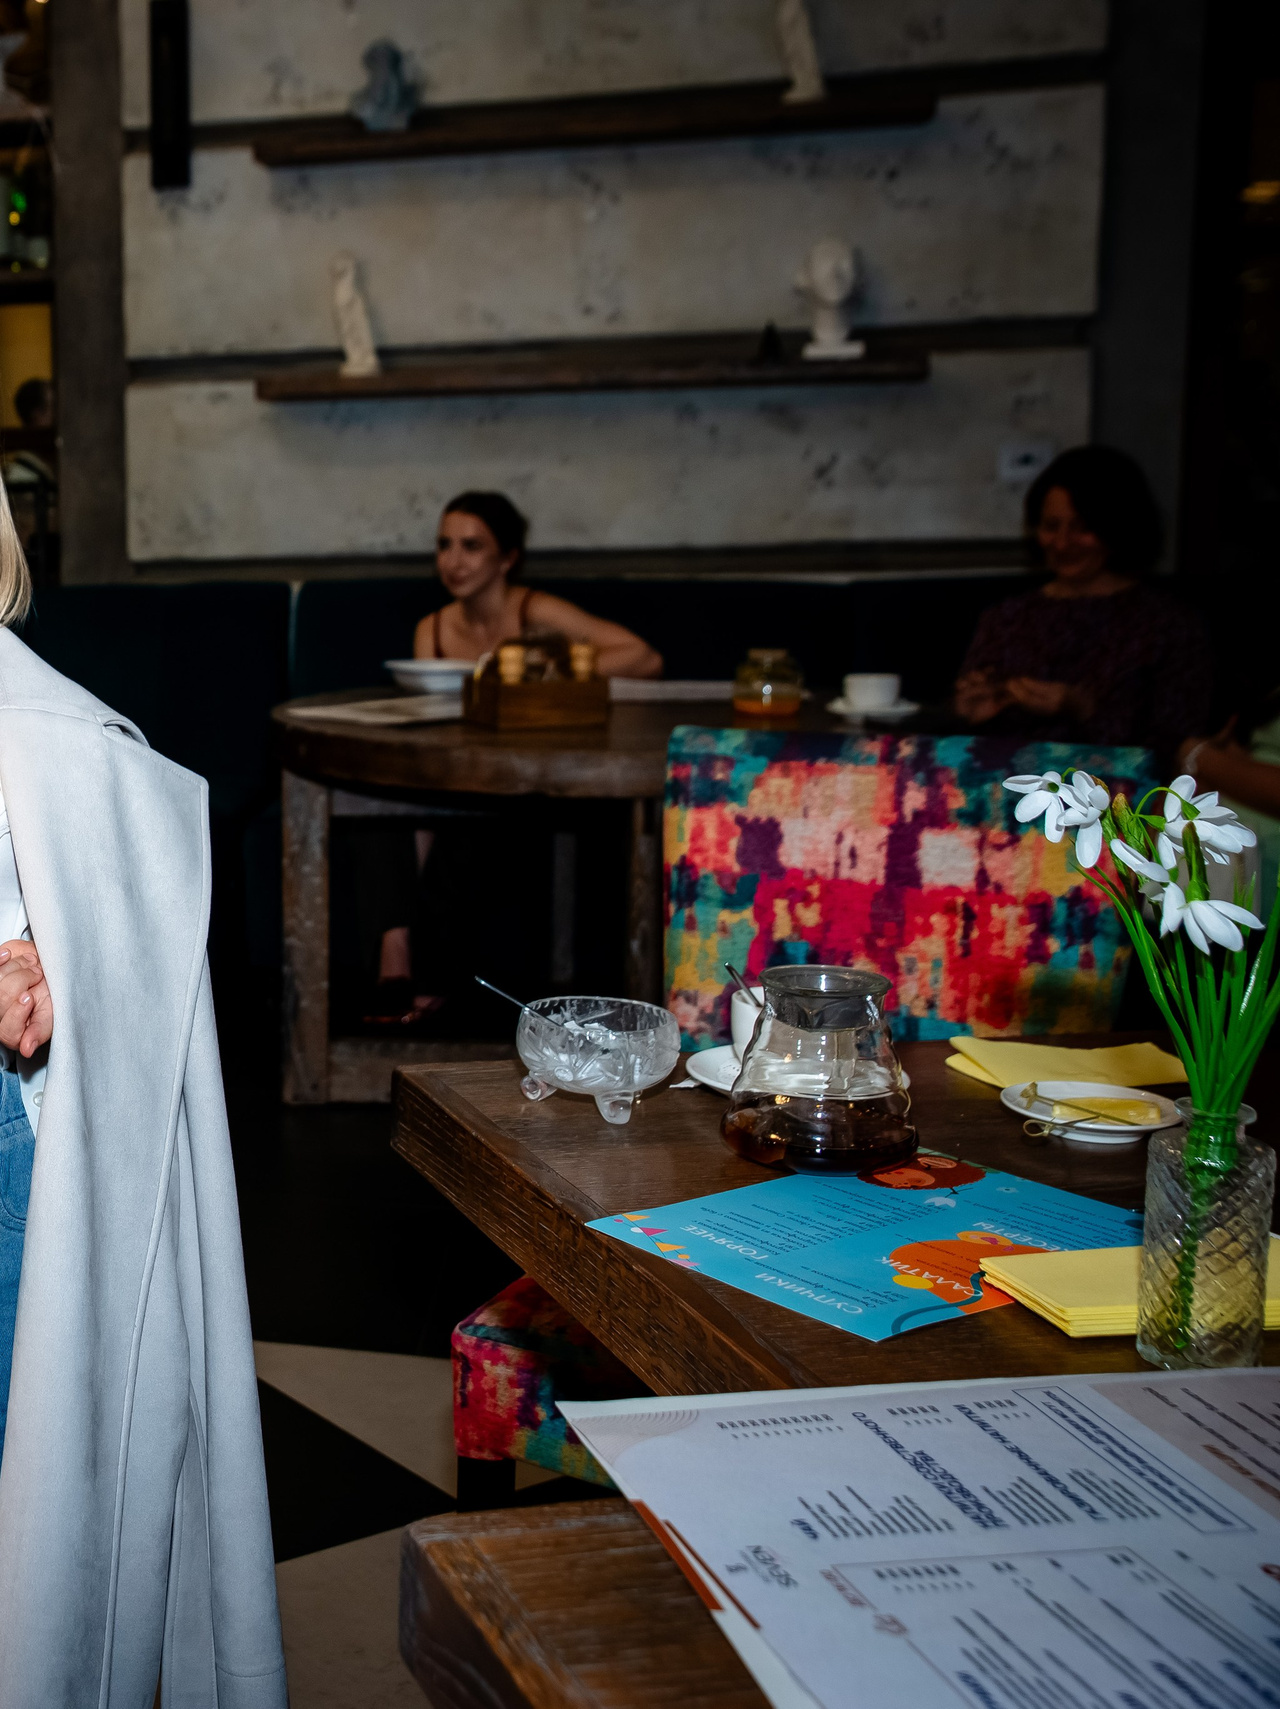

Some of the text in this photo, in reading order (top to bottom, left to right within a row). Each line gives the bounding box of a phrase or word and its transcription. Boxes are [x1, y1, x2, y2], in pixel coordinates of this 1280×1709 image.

[681, 1224, 767, 1259] ГОРЯЧЕЕ
[755, 1272, 864, 1314] СУПЧИКИ
[874, 1255, 984, 1297] САЛАТИК
[953, 1404, 1011, 1443] НАПИТКИ
[851, 1411, 940, 1480] СОБСТВЕННОГО
[910, 1449, 1012, 1528] ПРОИЗВОДСТВА
[1002, 1444, 1110, 1521] ГАЗИРОВАННЫЕ
[931, 1481, 995, 1529] НАПИТКИ
[790, 1518, 823, 1540] ЧАЙ
[745, 1544, 799, 1587] SEVEN
